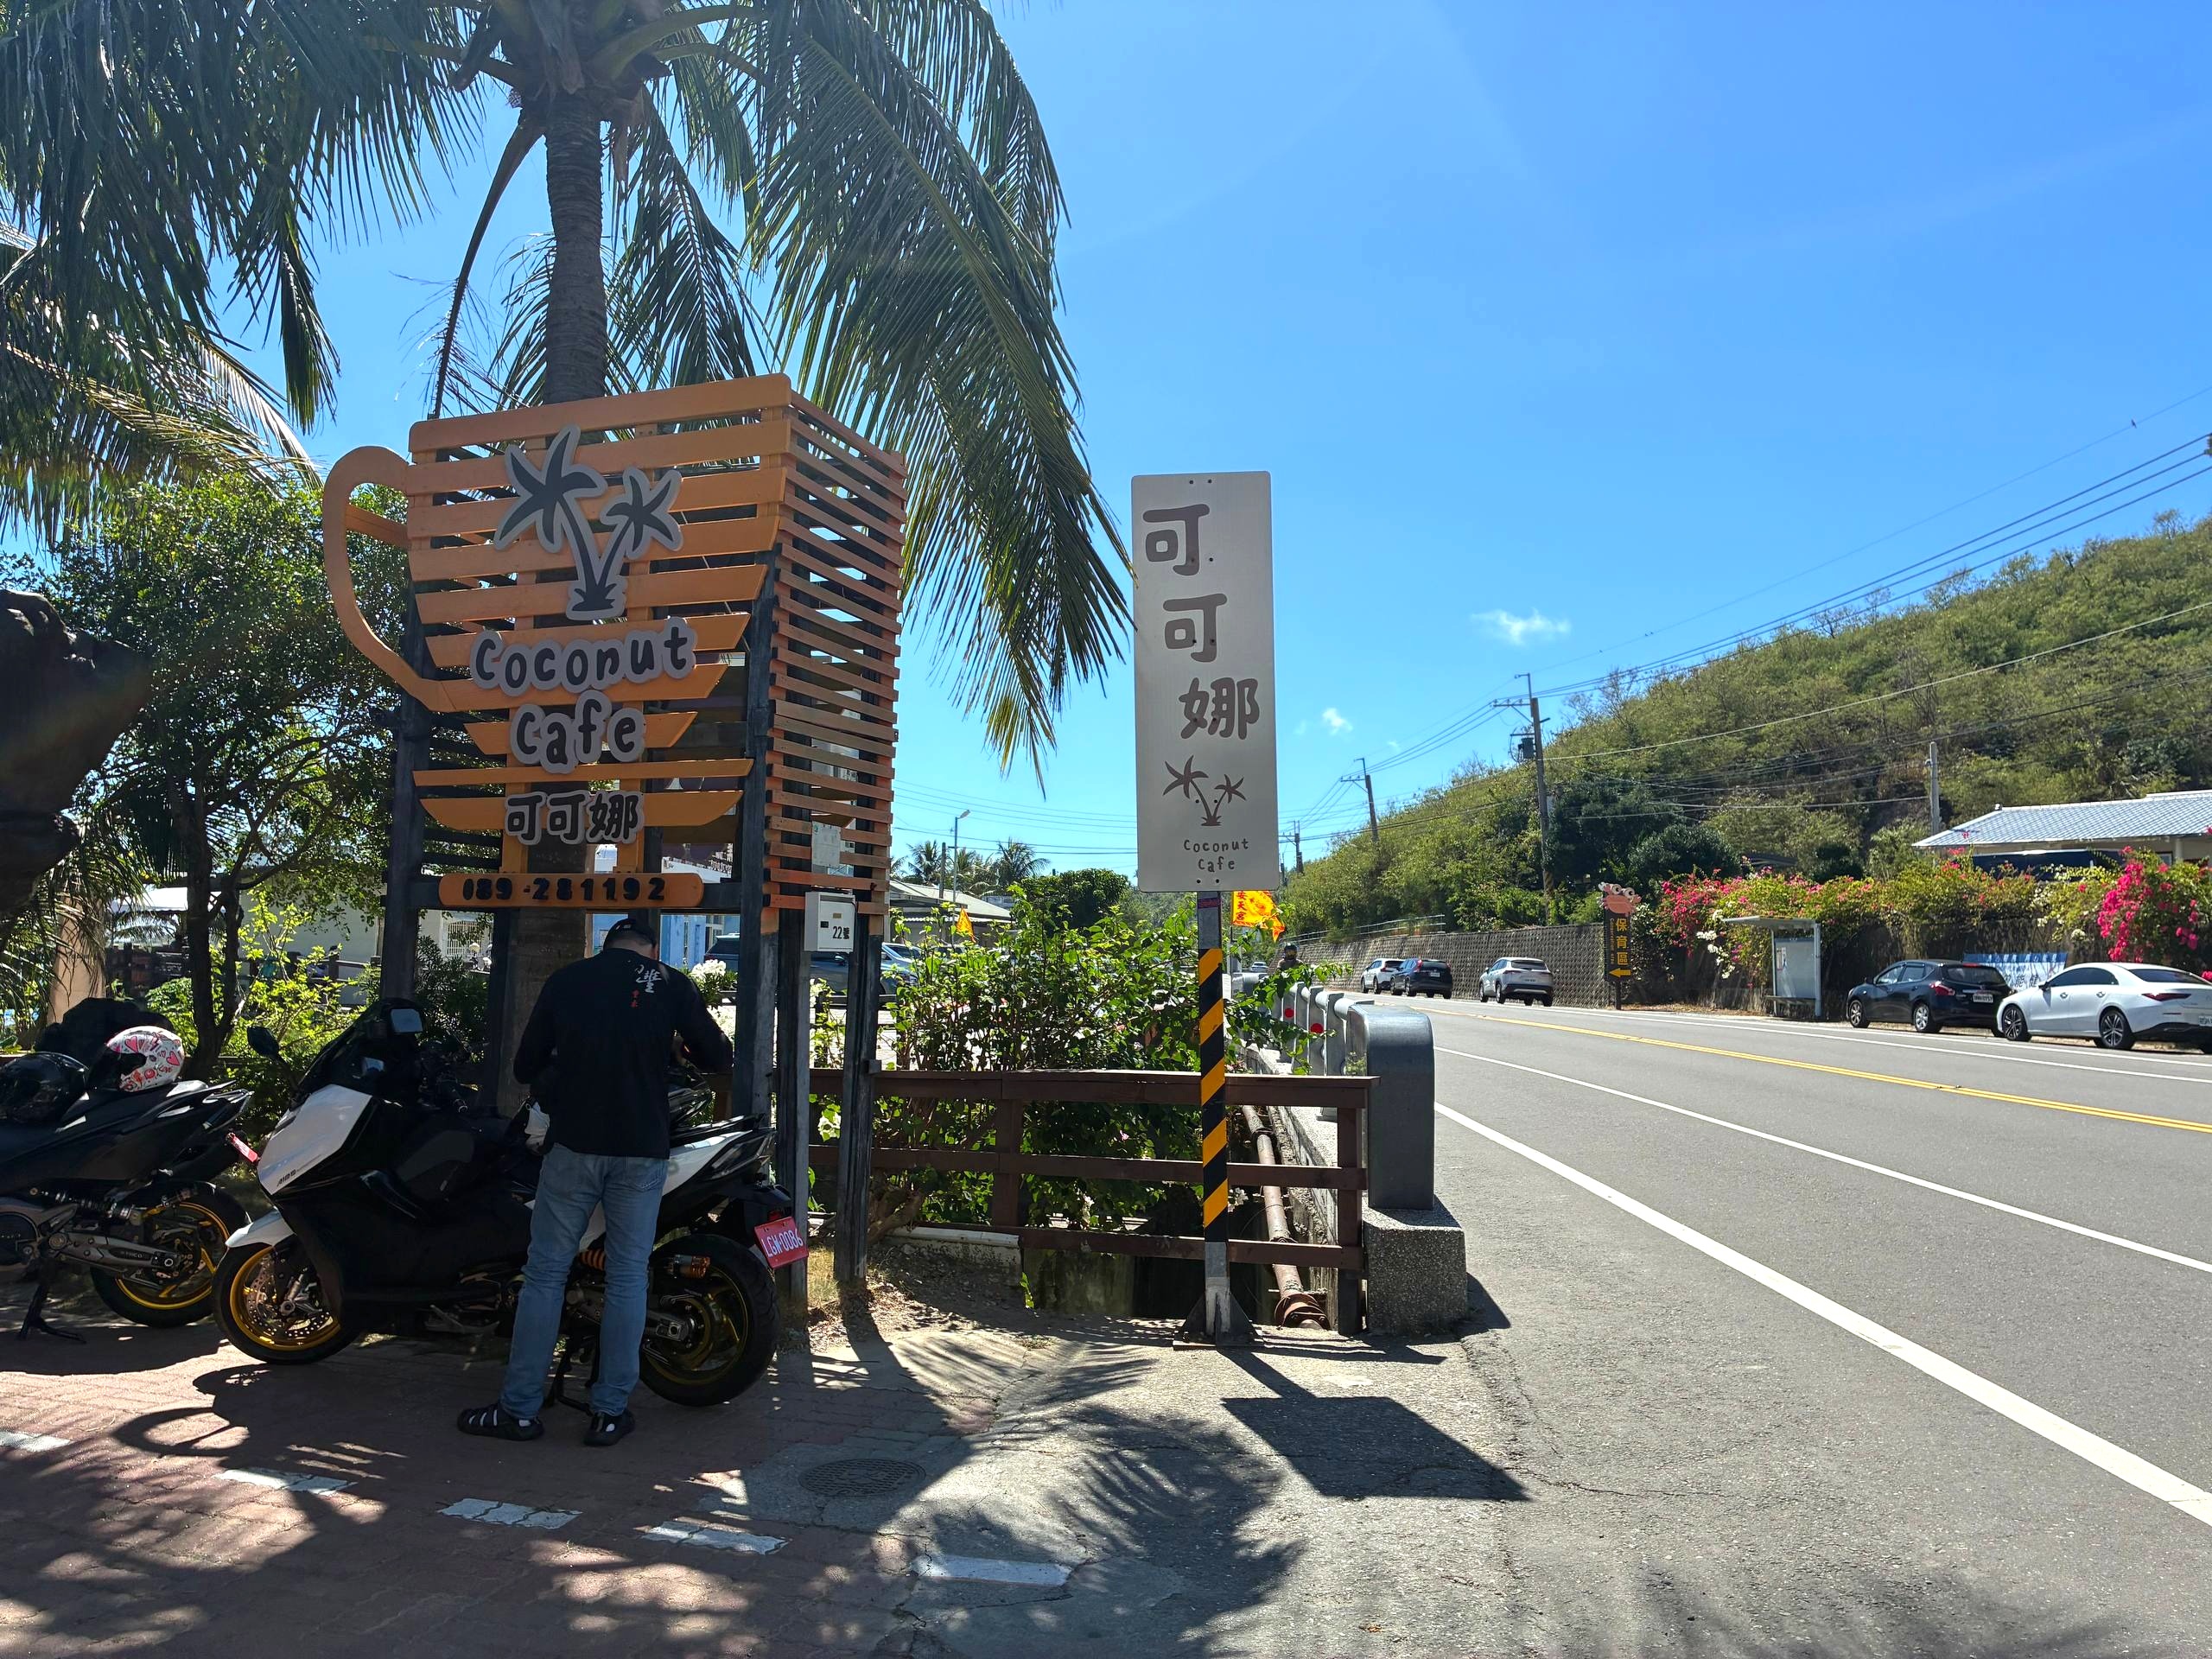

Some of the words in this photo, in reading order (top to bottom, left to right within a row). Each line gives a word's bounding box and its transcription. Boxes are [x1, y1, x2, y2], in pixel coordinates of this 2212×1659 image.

[1142, 503, 1260, 741] 可可娜
[475, 626, 689, 689] Coconut
[516, 698, 637, 766] Cafe
[506, 792, 640, 841] 可可娜
[1183, 837, 1249, 853] Coconut
[1198, 855, 1236, 873] Cafe
[1616, 918, 1629, 966] 保育區
